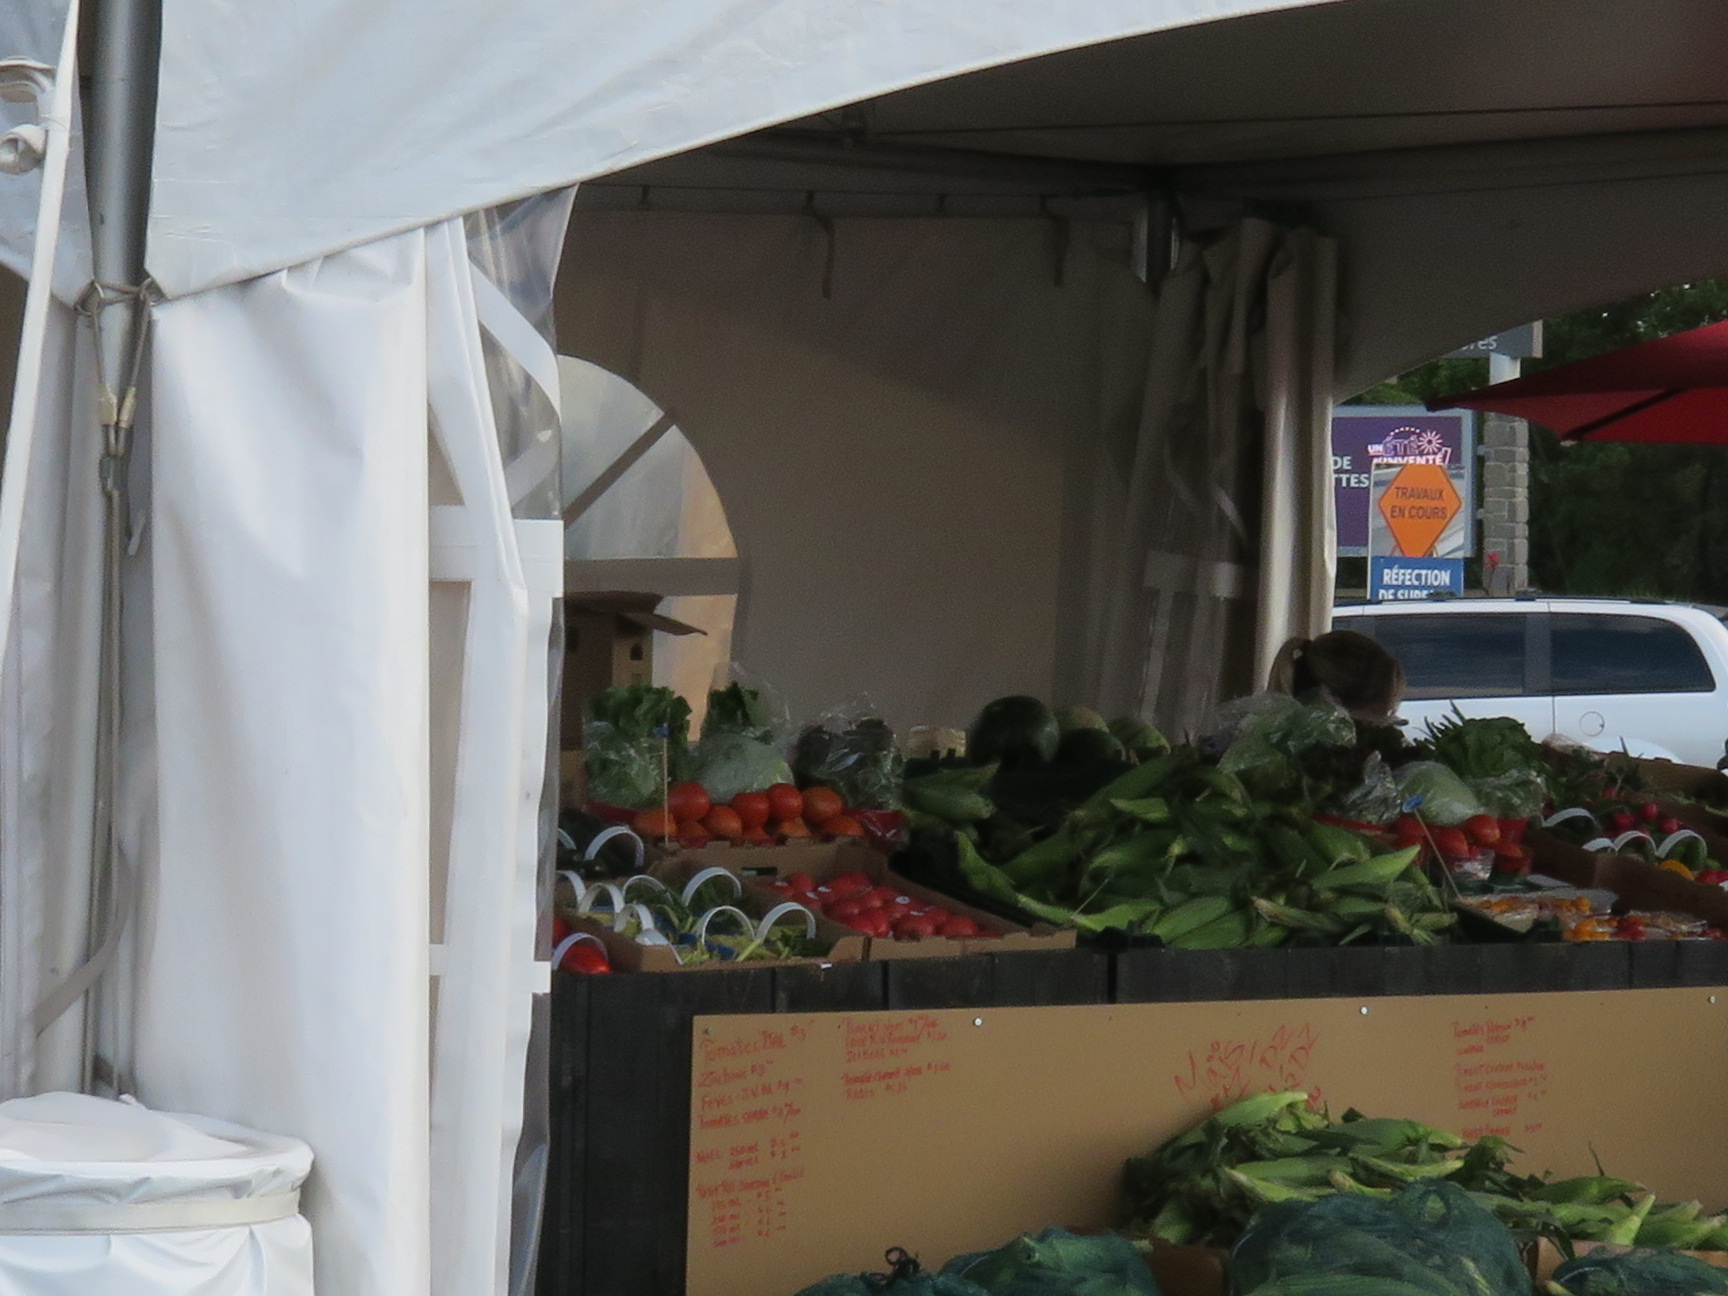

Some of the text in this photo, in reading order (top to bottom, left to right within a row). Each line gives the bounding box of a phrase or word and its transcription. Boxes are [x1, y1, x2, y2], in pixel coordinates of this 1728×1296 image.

[1367, 444, 1384, 456] UN
[1394, 487, 1444, 501] TRAVAUX
[1390, 506, 1448, 520] EN COURS
[1382, 564, 1451, 586] RÉFECTION
